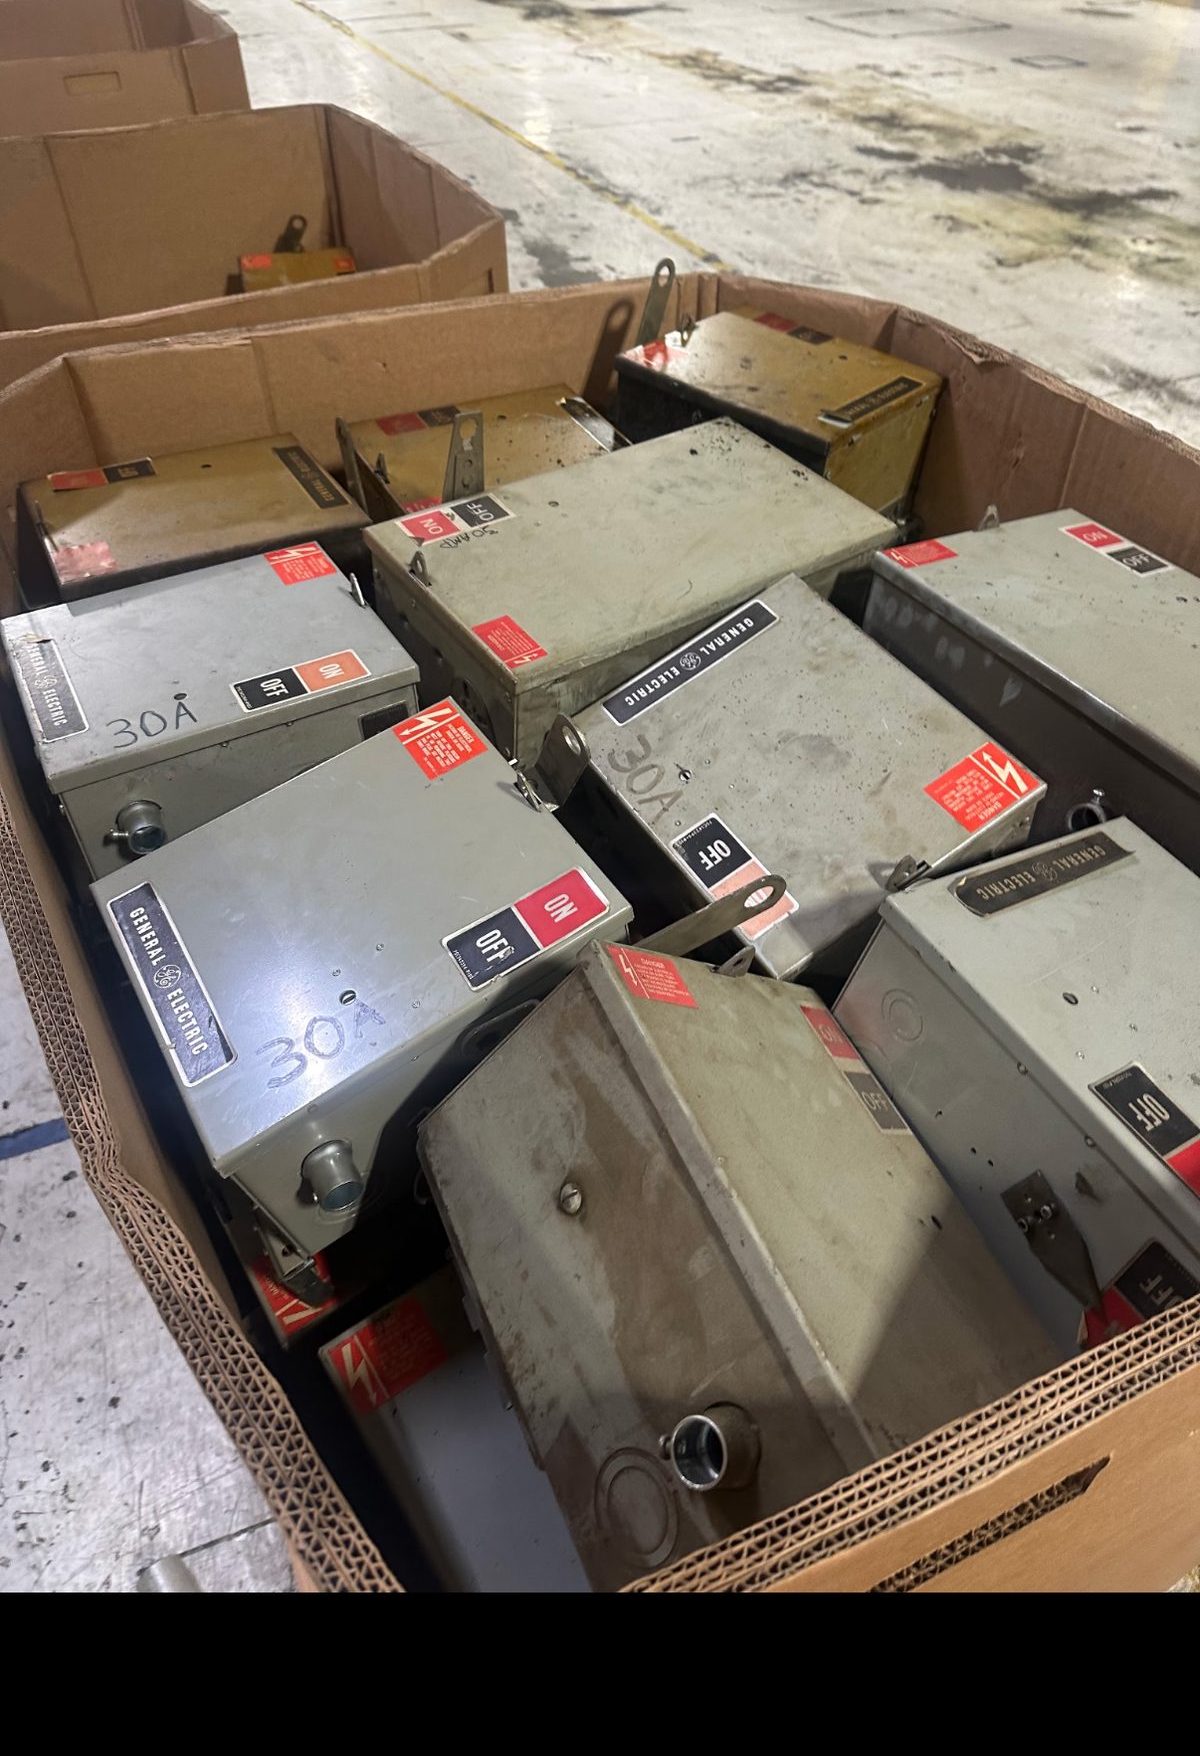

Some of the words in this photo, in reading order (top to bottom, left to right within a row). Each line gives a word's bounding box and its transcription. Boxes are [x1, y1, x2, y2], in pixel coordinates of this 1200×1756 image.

[420, 518, 443, 535] ON
[466, 502, 494, 521] OFF
[1082, 531, 1108, 542] ON
[1122, 553, 1150, 567] OFF
[699, 617, 754, 655] GENERAL
[319, 663, 345, 680] ON
[624, 665, 681, 706] ELECTRIC
[260, 678, 289, 697] OFF
[42, 688, 68, 726] ELECTRIC
[106, 701, 197, 748] 30A
[607, 734, 684, 825] 30A
[698, 839, 731, 871] OFF
[1052, 844, 1106, 871] GENERAL
[976, 871, 1036, 900] ELECTRIC
[543, 893, 578, 923] ON
[475, 929, 515, 963] OFF
[129, 906, 167, 966] GENERAL
[166, 987, 209, 1056] ELECTRIC
[256, 999, 387, 1089] 30A
[861, 1091, 889, 1112] OFF
[1128, 1093, 1170, 1131] OFF
